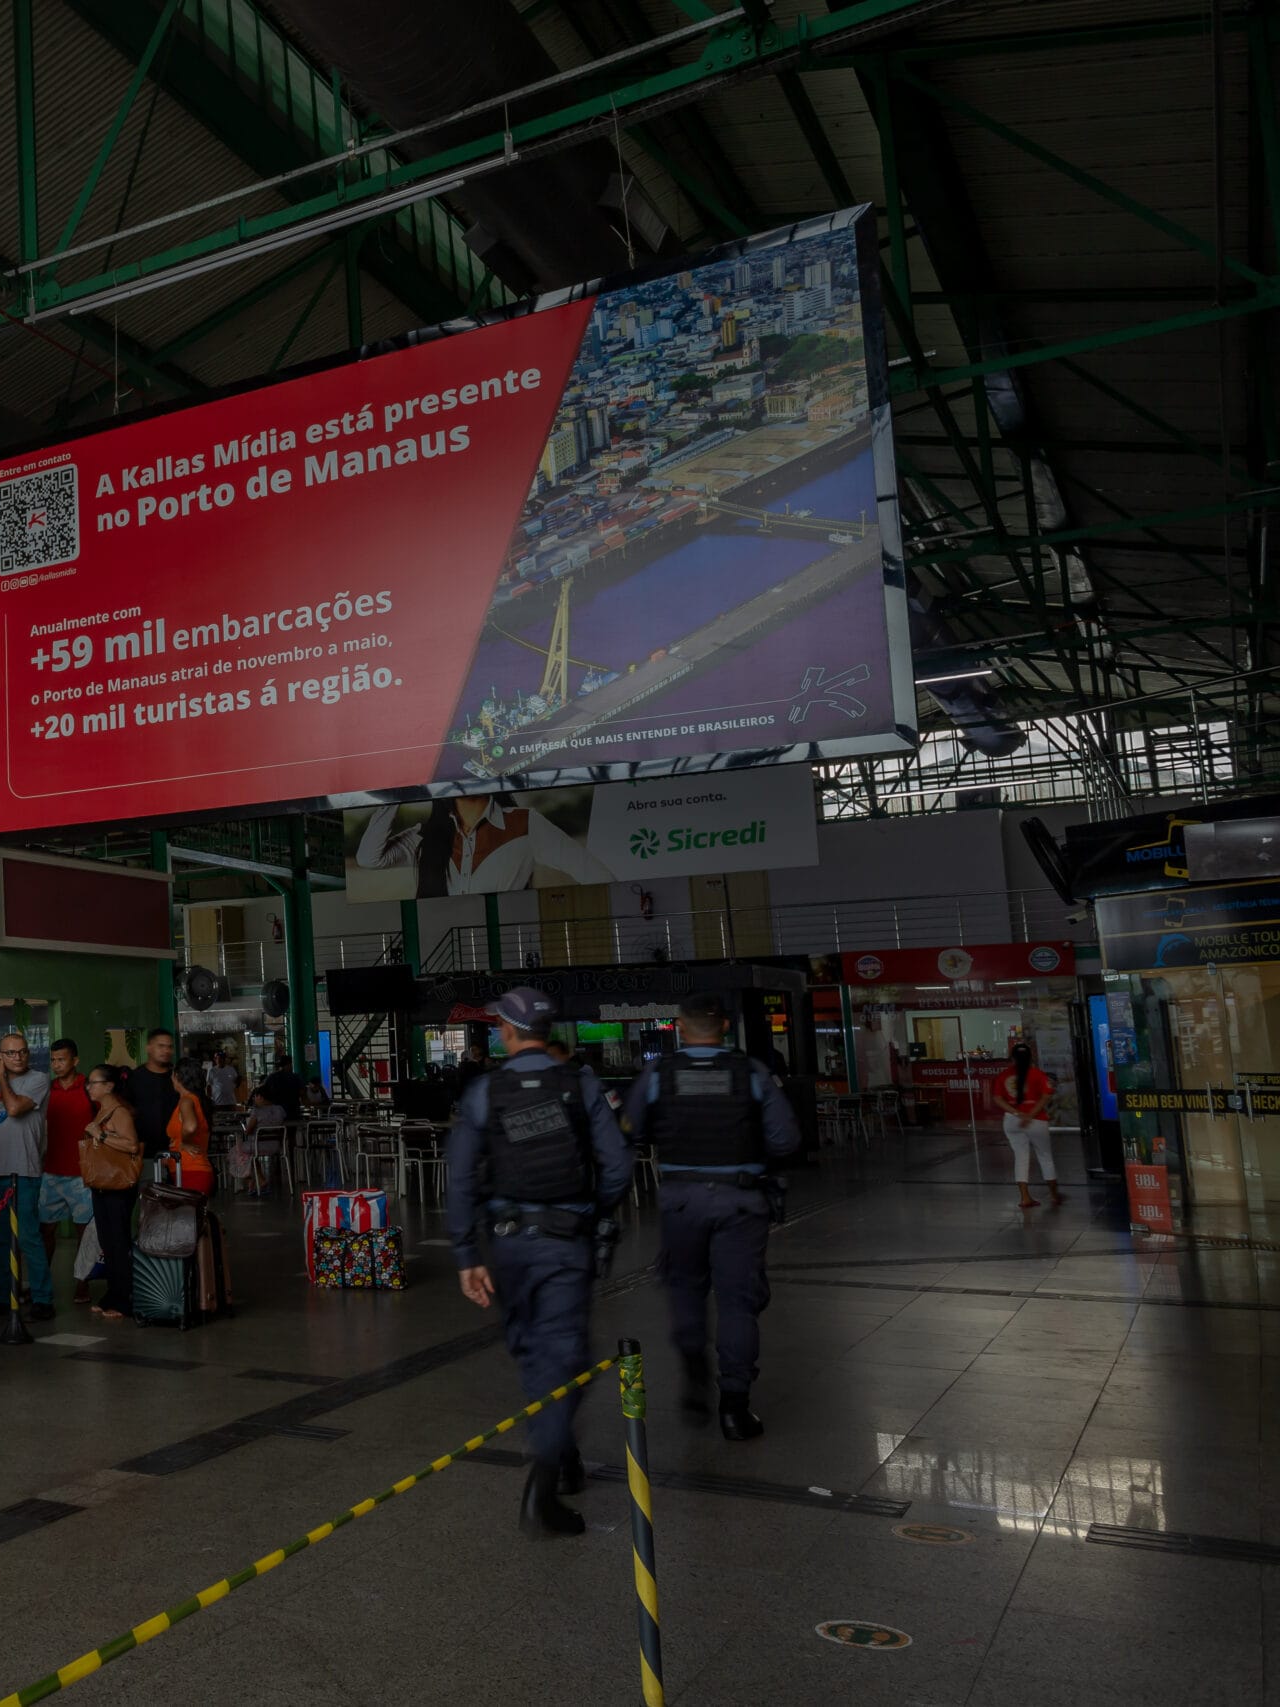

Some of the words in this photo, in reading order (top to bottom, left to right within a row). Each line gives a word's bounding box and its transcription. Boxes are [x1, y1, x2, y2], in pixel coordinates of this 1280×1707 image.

[95, 474, 115, 498] A
[122, 452, 205, 491] Kallas
[214, 427, 296, 468] Mídia
[305, 403, 374, 443] está
[384, 368, 541, 432] presente
[0, 465, 22, 478] Entre
[23, 461, 37, 472] em
[38, 452, 71, 469] contato
[97, 508, 130, 532] no
[137, 482, 235, 527] Porto
[246, 466, 292, 500] de
[304, 425, 470, 487] Manaus
[30, 611, 109, 637] Anualmente
[113, 606, 141, 621] com
[31, 635, 93, 672] +59
[105, 618, 166, 663] mil
[173, 590, 392, 650] embarcações
[31, 694, 39, 705] o
[44, 684, 82, 703] Porto
[86, 681, 104, 696] de
[108, 672, 167, 695] Manaus
[171, 662, 208, 682] atrai
[213, 659, 232, 675] de
[237, 645, 323, 671] novembro
[328, 643, 338, 656] a
[343, 633, 392, 653] maio,
[31, 712, 75, 739] +20
[83, 703, 125, 734] mil
[133, 688, 251, 726] turistas
[260, 678, 278, 706] á
[288, 663, 403, 704] região.
[509, 745, 519, 755] A
[519, 740, 568, 754] EMPRESA
[570, 737, 592, 750] QUE
[595, 734, 623, 745] MAIS
[626, 728, 678, 742] ENTENDE
[680, 724, 695, 736] DE
[698, 715, 775, 733] BRASILEIROS
[627, 798, 657, 811] Abra
[660, 797, 682, 808] sua
[686, 794, 727, 804] conta.
[667, 821, 766, 852] Sicredi
[1195, 933, 1249, 947] MOBILLE
[1126, 1094, 1158, 1108] SEJAM
[1161, 1094, 1183, 1108] BEM
[1135, 1174, 1160, 1187] JBL
[1139, 1205, 1163, 1217] JBL
